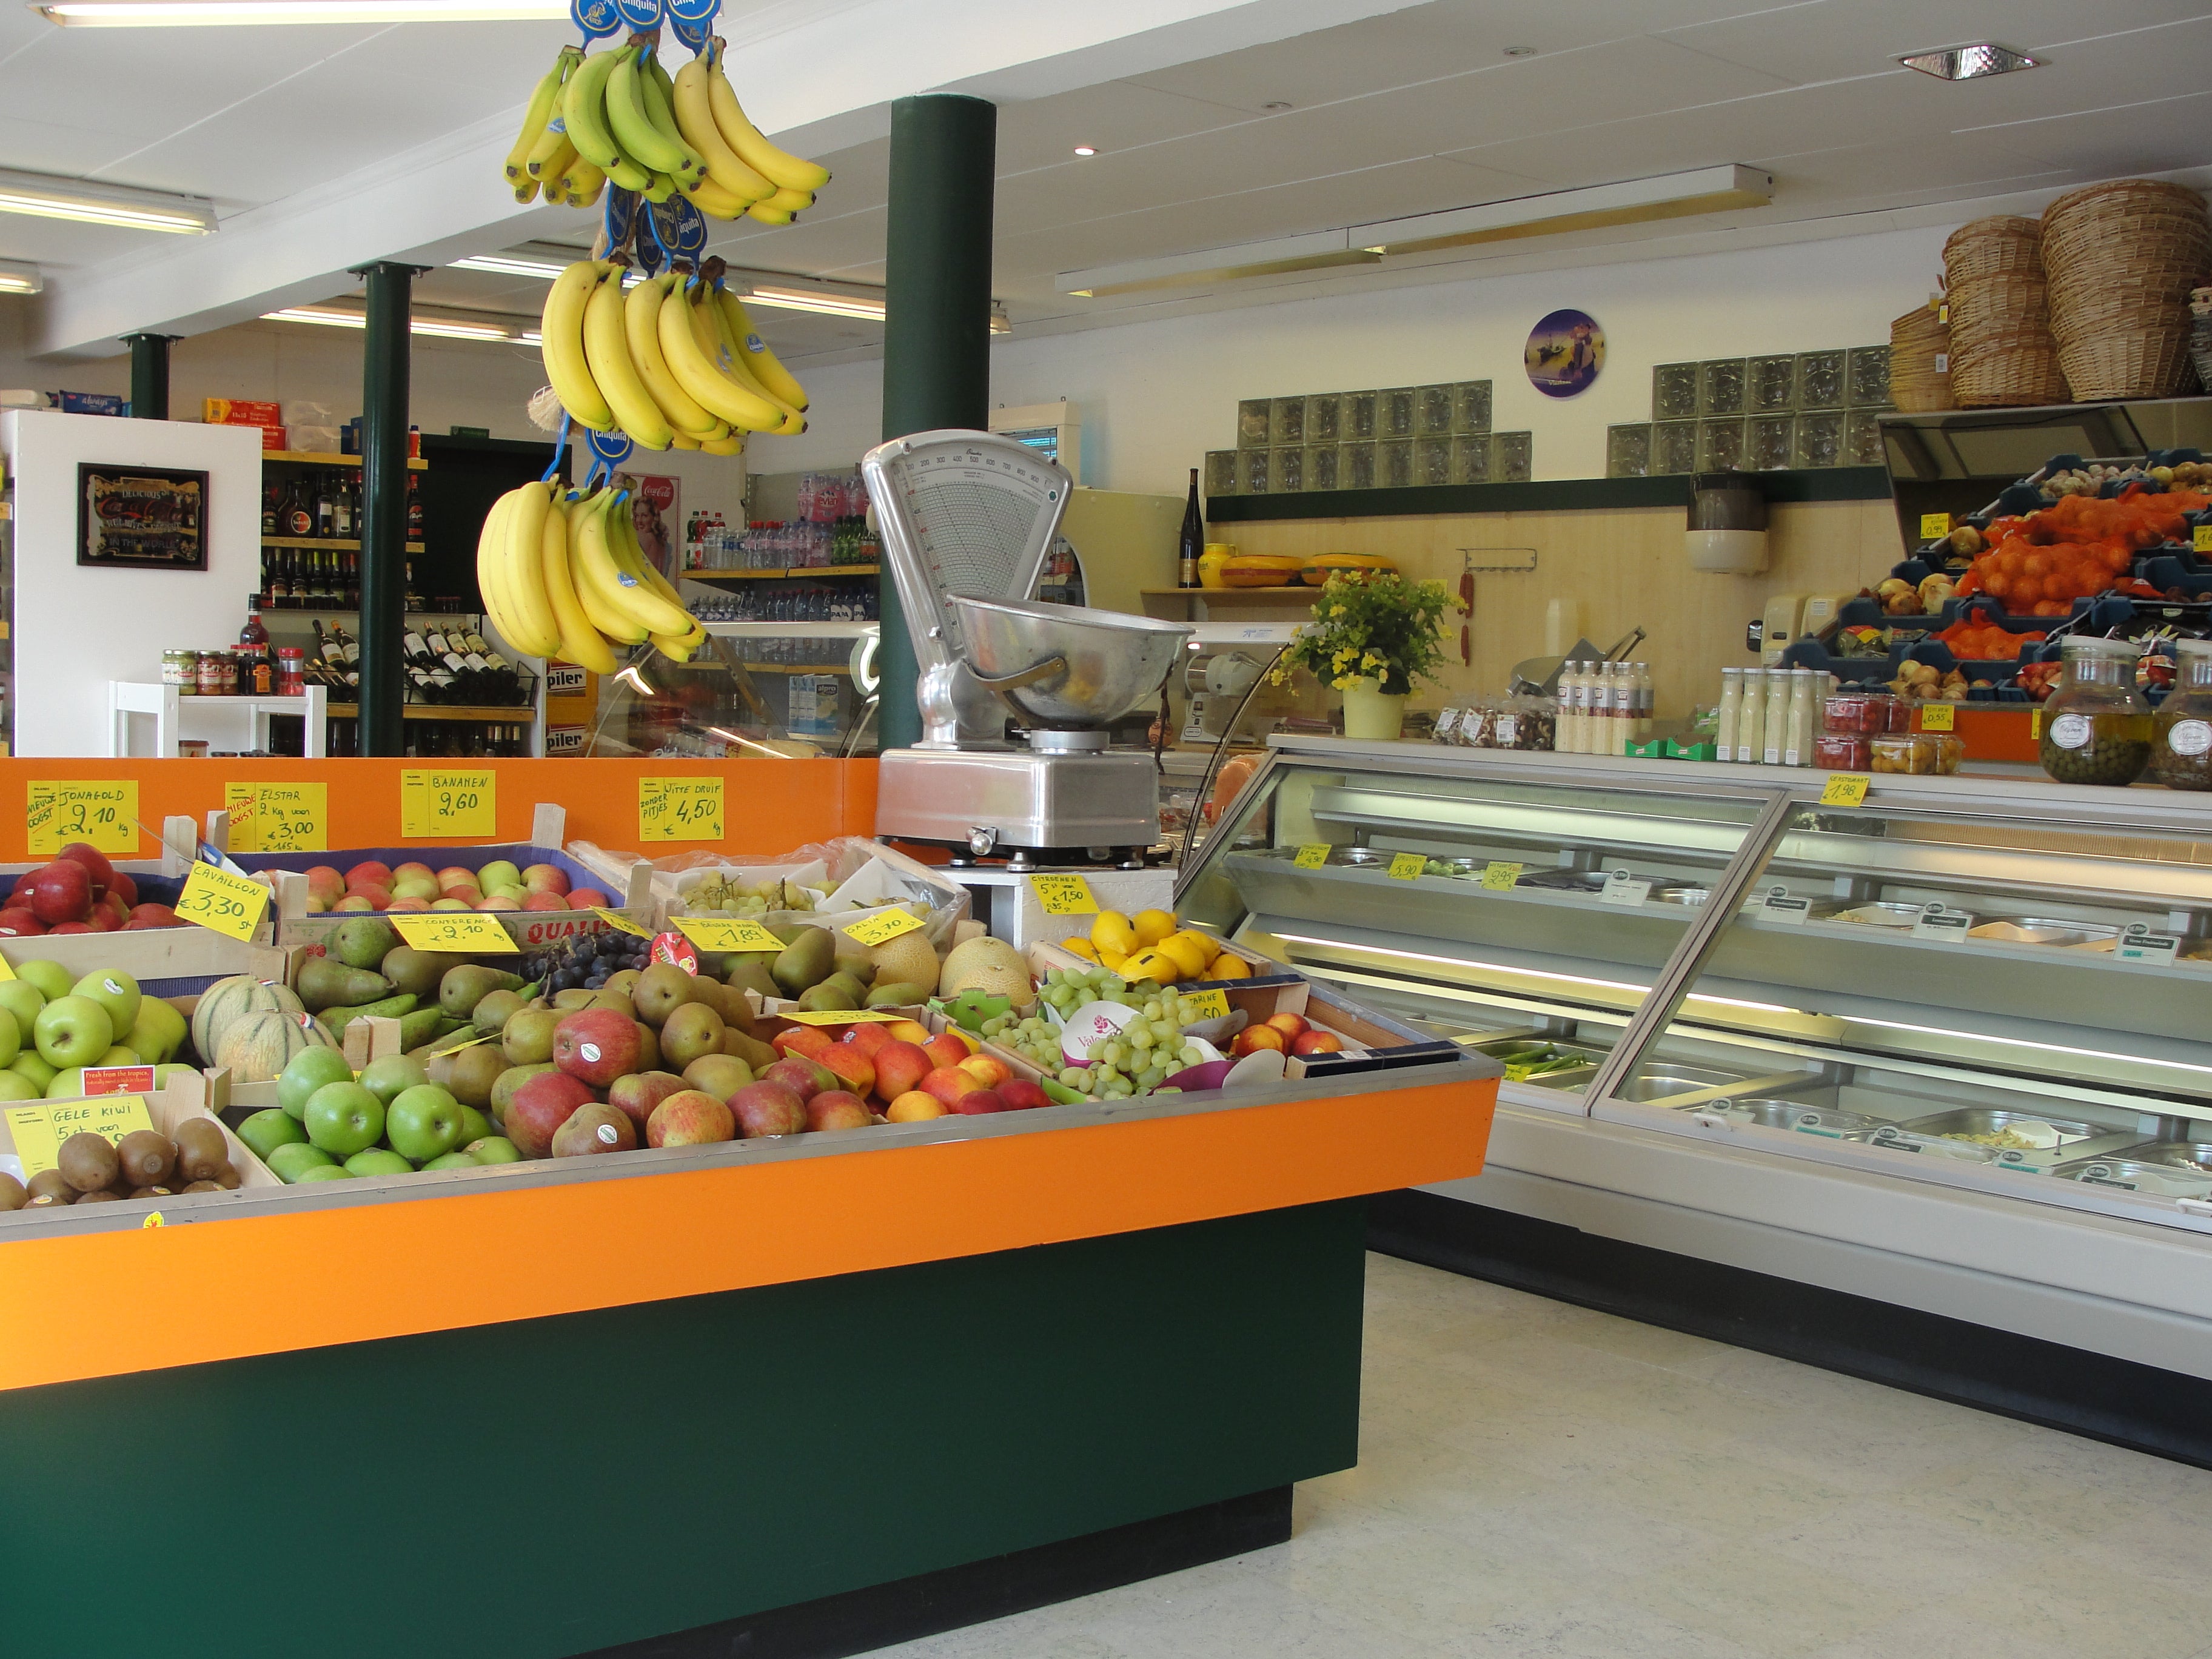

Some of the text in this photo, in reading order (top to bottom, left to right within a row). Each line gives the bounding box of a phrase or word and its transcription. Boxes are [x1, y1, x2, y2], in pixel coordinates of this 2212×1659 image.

[819, 497, 838, 506] evian
[547, 671, 583, 689] piler
[546, 733, 582, 751] piler
[433, 777, 488, 788] BANANEN
[58, 790, 124, 806] JONAGOLD
[260, 790, 301, 800] ELSTAR
[640, 793, 668, 808] ZONDER
[227, 793, 256, 813] NIEUWE
[1189, 993, 1217, 1004] TARINE
[54, 1109, 91, 1122] GELE
[58, 1126, 69, 1140] 5
